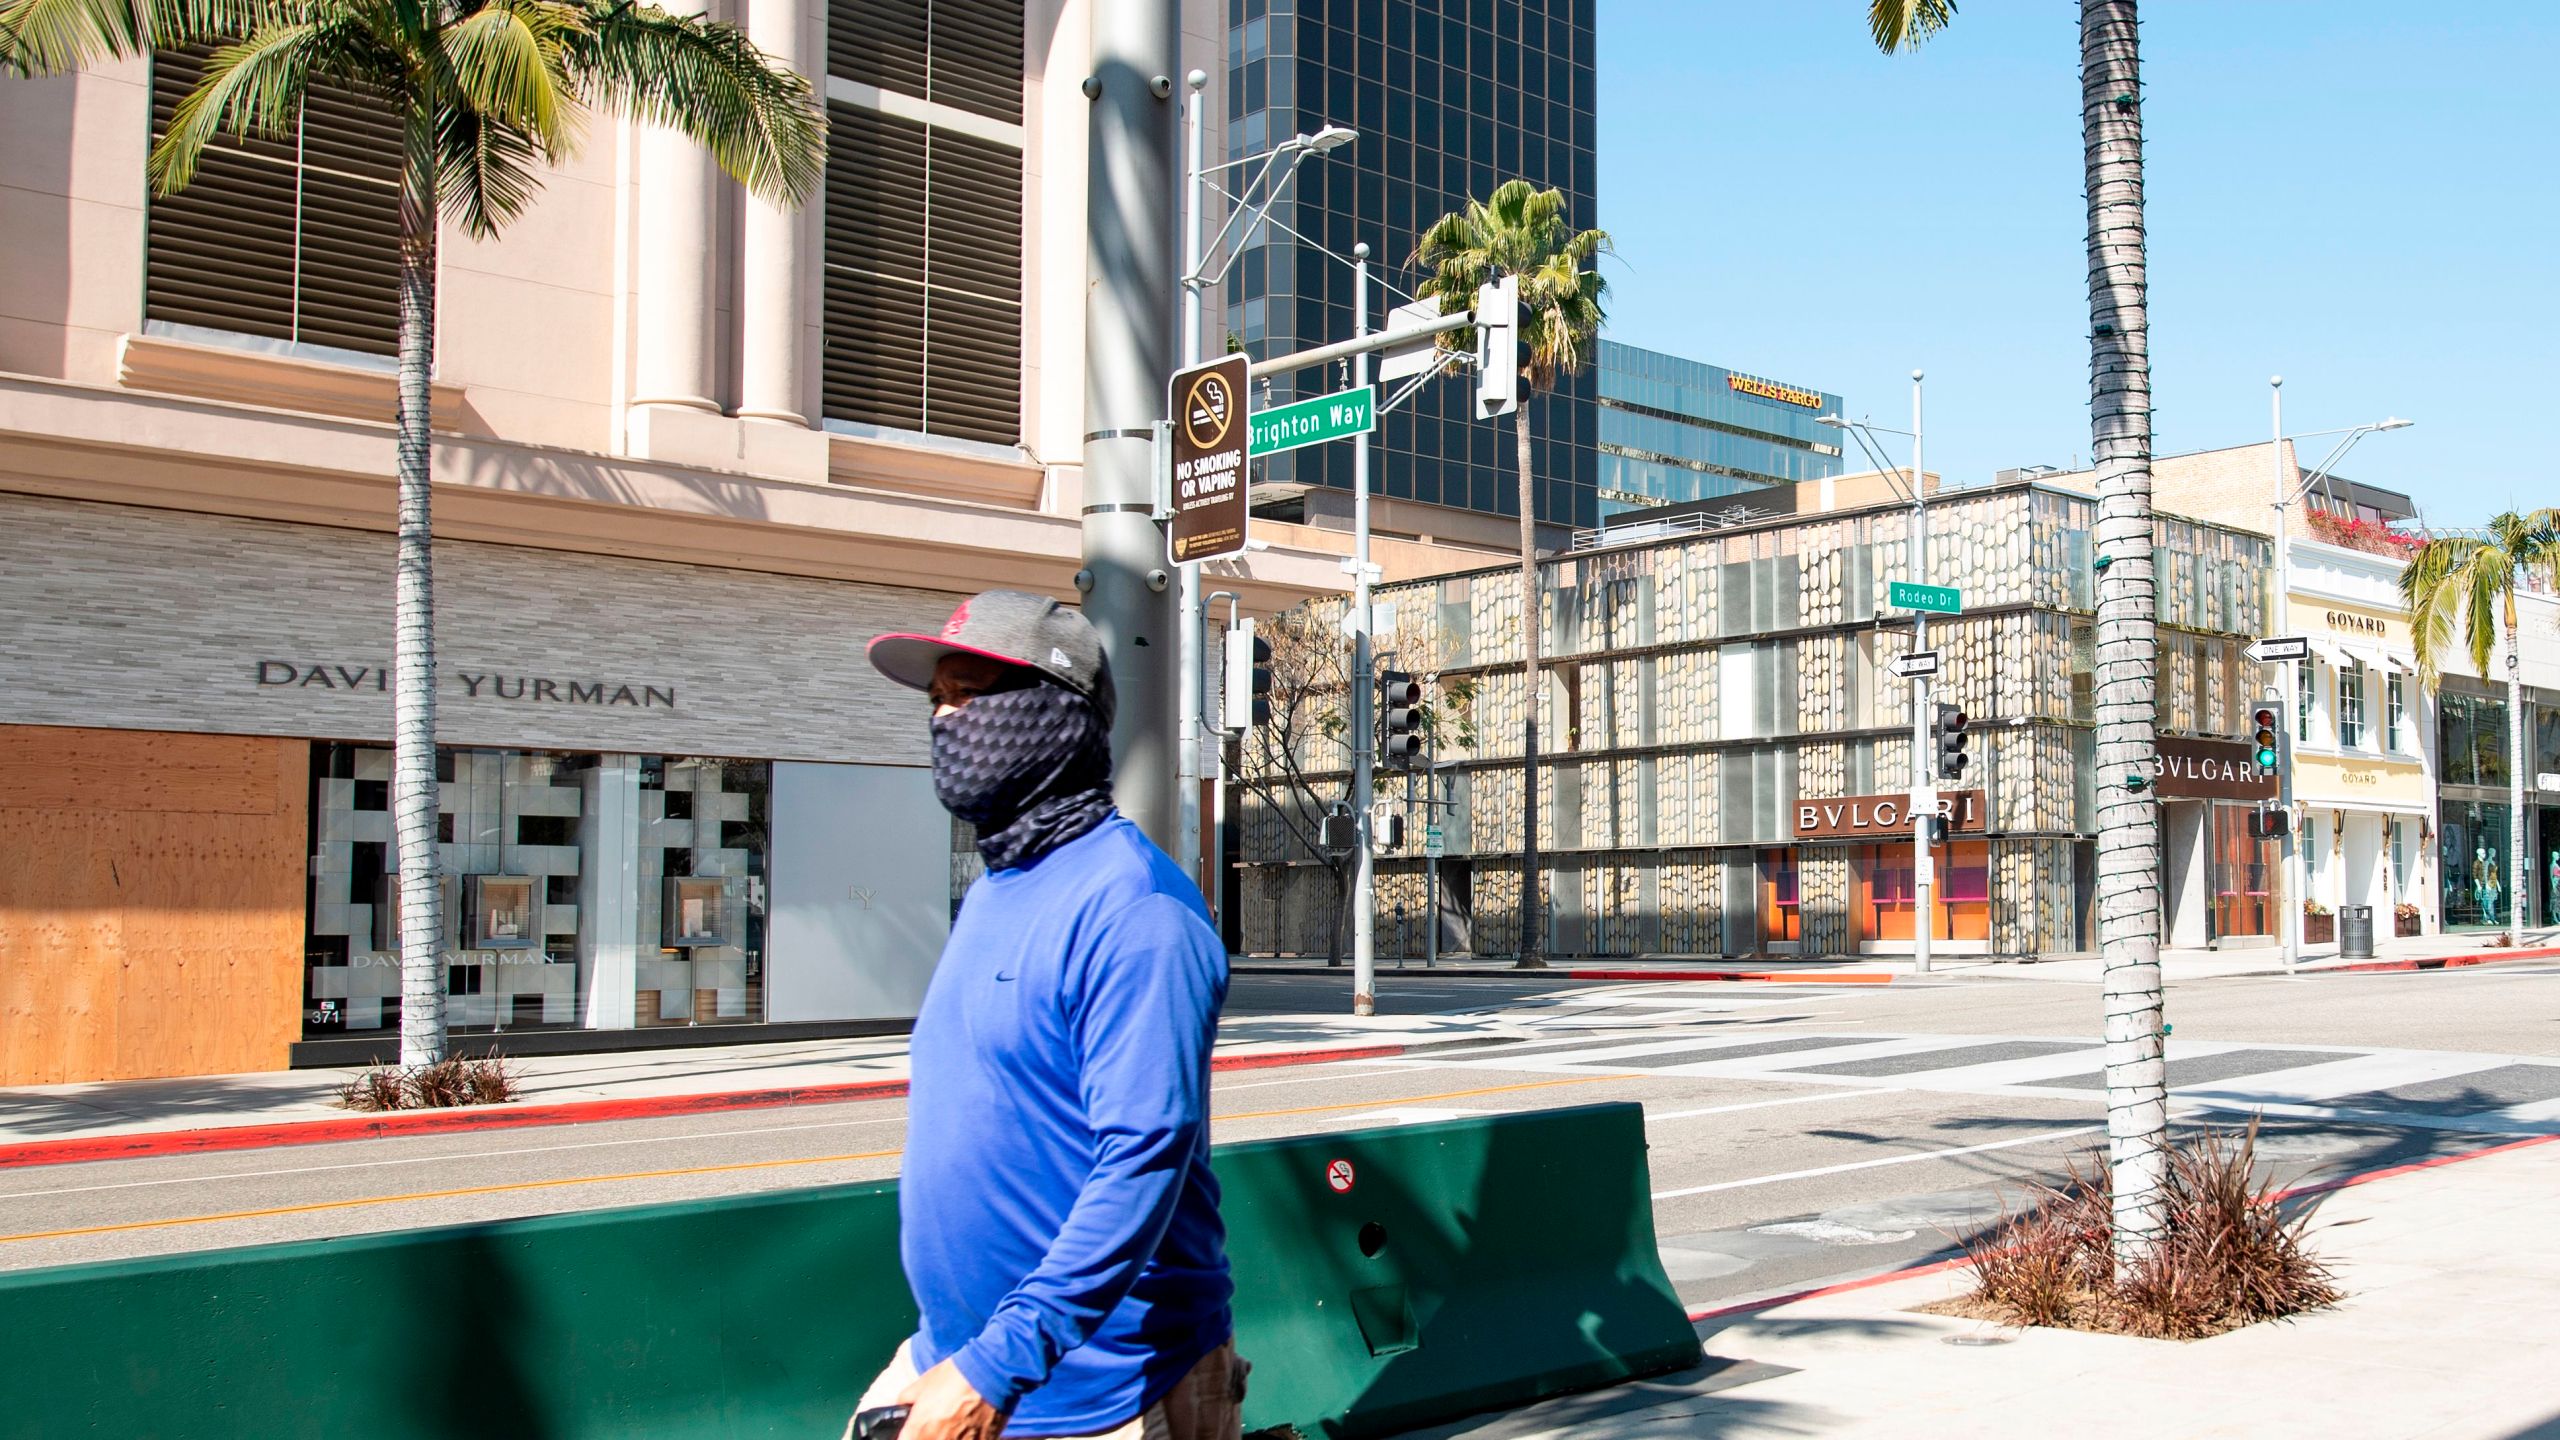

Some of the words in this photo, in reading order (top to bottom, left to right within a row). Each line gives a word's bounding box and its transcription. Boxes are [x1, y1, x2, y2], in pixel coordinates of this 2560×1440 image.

[1730, 376, 1777, 399] WELLS
[1779, 387, 1822, 409] FARGO
[1329, 404, 1364, 428] Way
[1176, 462, 1192, 481] NO
[1194, 449, 1241, 476] SMOKING
[1182, 480, 1196, 498] OR
[1198, 470, 1236, 494] VAPING
[1899, 589, 1933, 604] Rodeo
[1940, 593, 1952, 606] Dr
[2327, 611, 2385, 632] GOYARD
[2263, 645, 2279, 654] ONE
[2283, 644, 2299, 653] WAY
[257, 660, 387, 692] DAVI
[458, 673, 675, 709] YURMAN
[2342, 773, 2377, 785] GOYARD
[446, 952, 556, 966] YURMAN
[312, 1010, 339, 1024] 371
